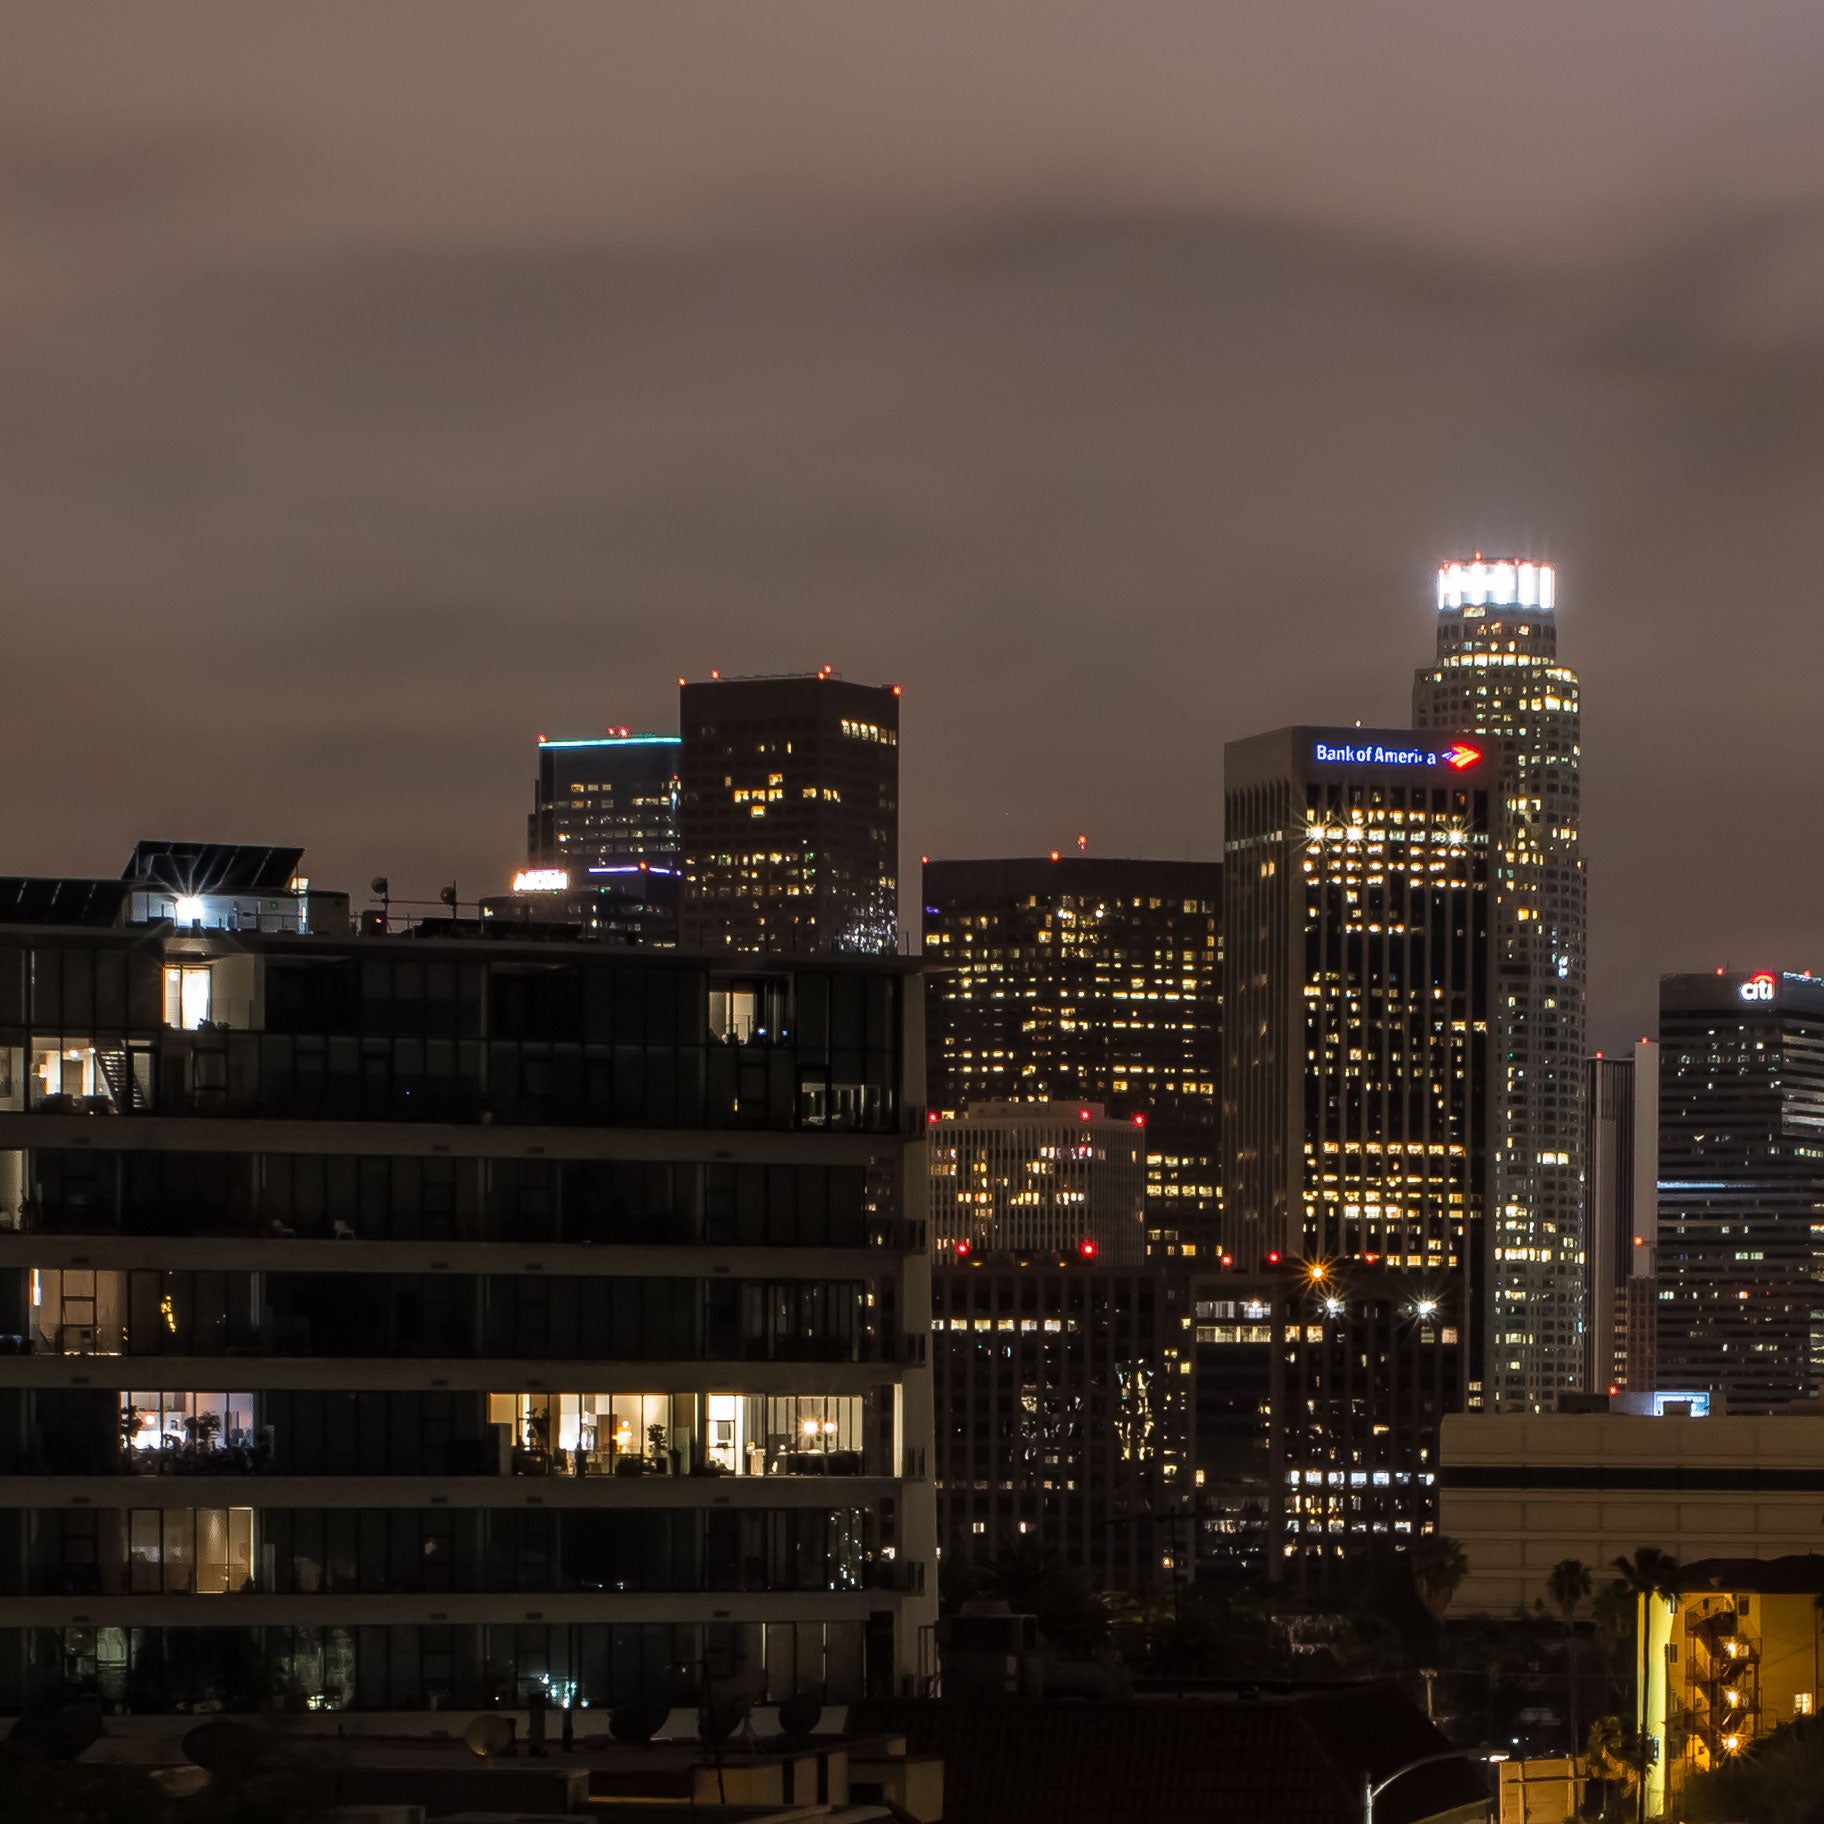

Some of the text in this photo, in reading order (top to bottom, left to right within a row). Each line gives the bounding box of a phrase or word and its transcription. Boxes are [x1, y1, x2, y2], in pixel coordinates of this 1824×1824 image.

[1316, 744, 1437, 766] Bank of Ameria
[1740, 978, 1774, 1001] citi
